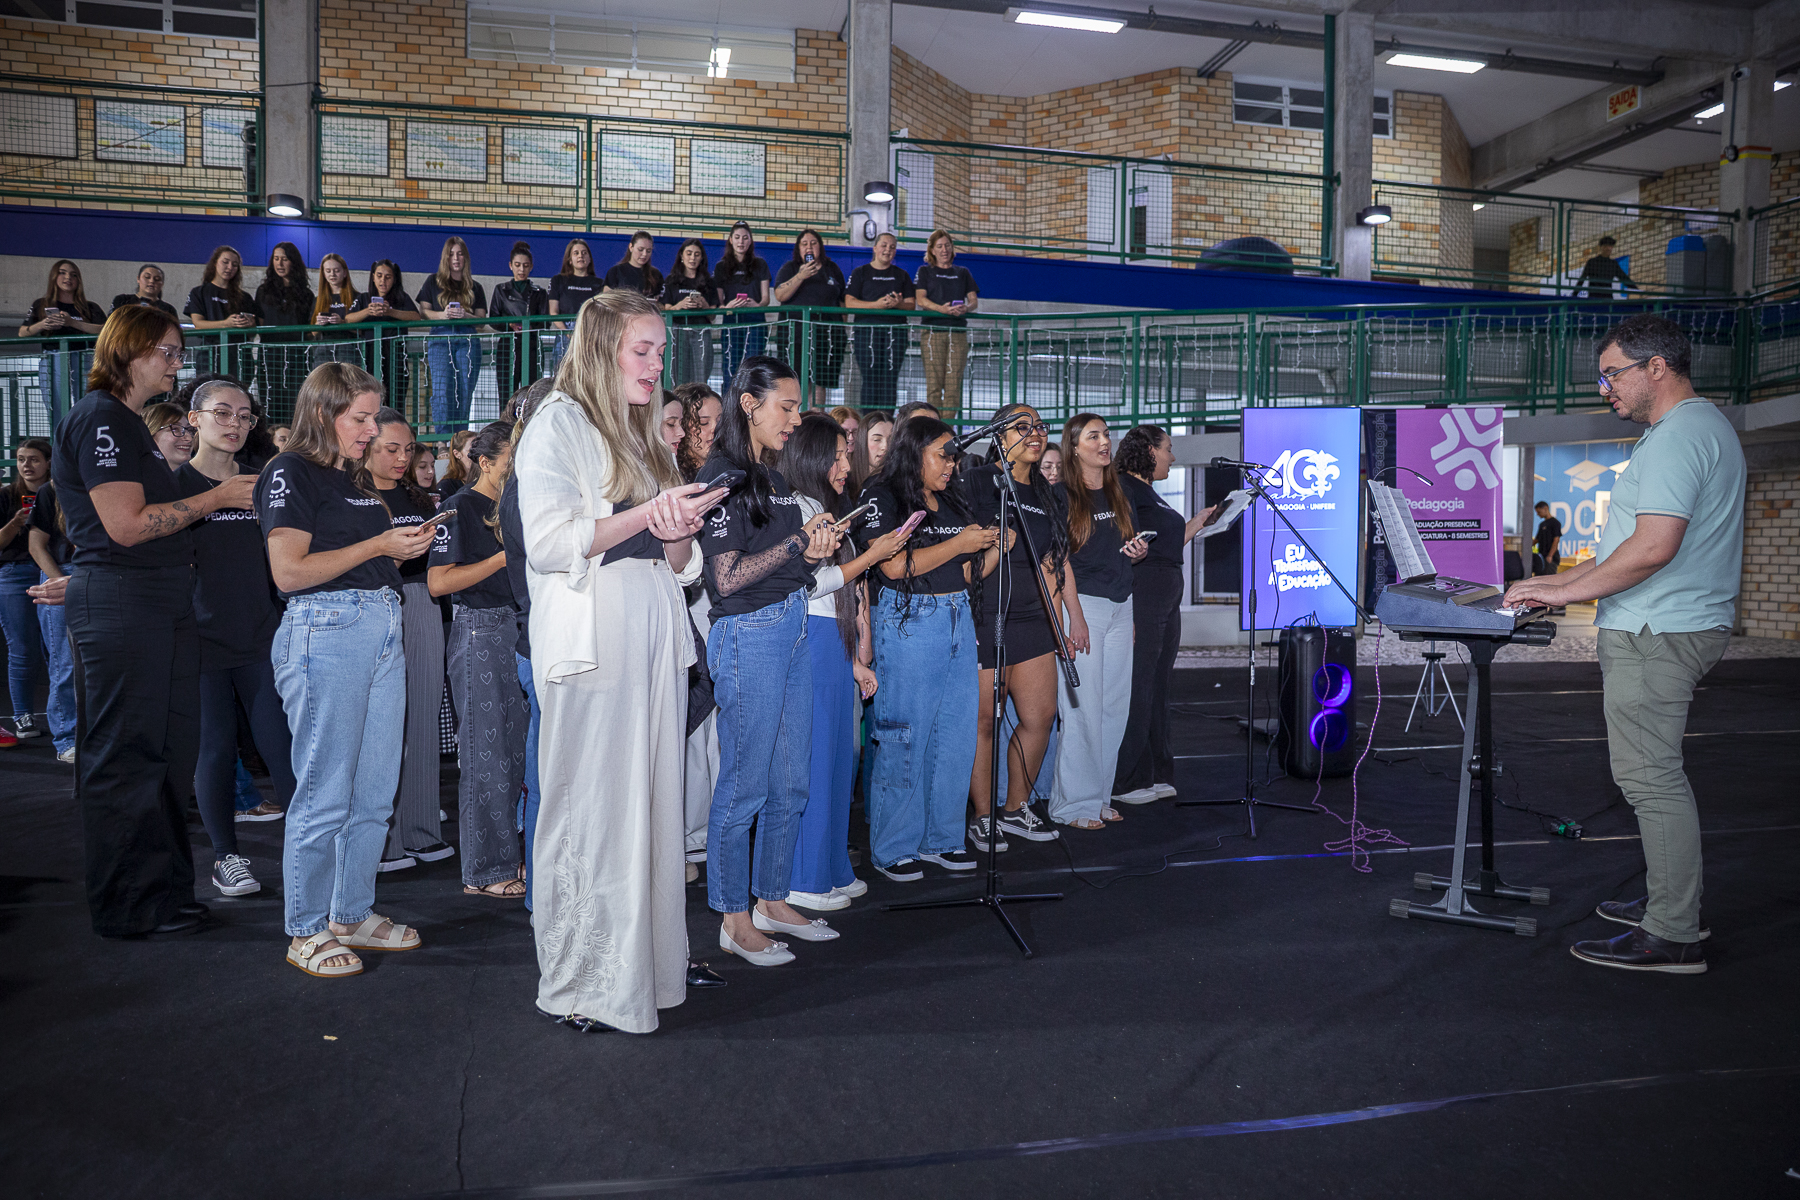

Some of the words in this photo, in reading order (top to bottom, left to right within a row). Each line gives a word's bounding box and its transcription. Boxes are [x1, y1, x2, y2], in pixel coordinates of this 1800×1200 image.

[96, 425, 115, 452] 5
[1372, 412, 1388, 476] Pedagogia
[270, 468, 286, 494] 5
[1406, 497, 1465, 512] Pedagogia
[1415, 520, 1444, 529] ADUAÇÃO
[1285, 543, 1306, 561] EU
